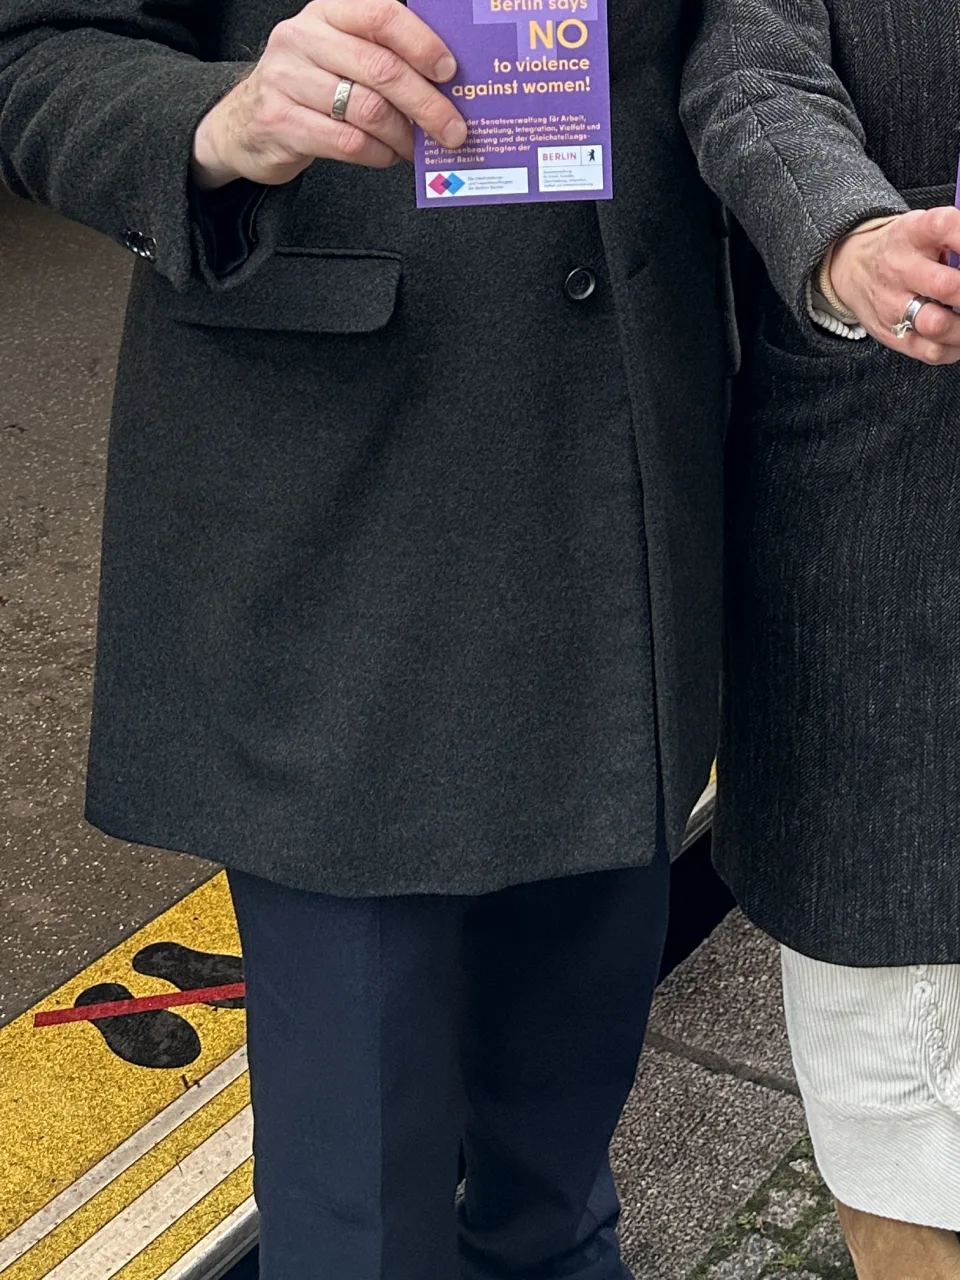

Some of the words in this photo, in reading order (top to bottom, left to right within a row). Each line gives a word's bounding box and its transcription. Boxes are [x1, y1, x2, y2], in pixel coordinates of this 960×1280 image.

[529, 18, 588, 49] NO
[494, 58, 511, 72] to
[516, 56, 590, 71] violence
[452, 80, 517, 100] against
[523, 76, 590, 94] women!
[515, 125, 558, 133] Integration,
[559, 123, 585, 131] Vielfalt
[518, 144, 531, 152] der
[542, 152, 577, 161] BERLIN
